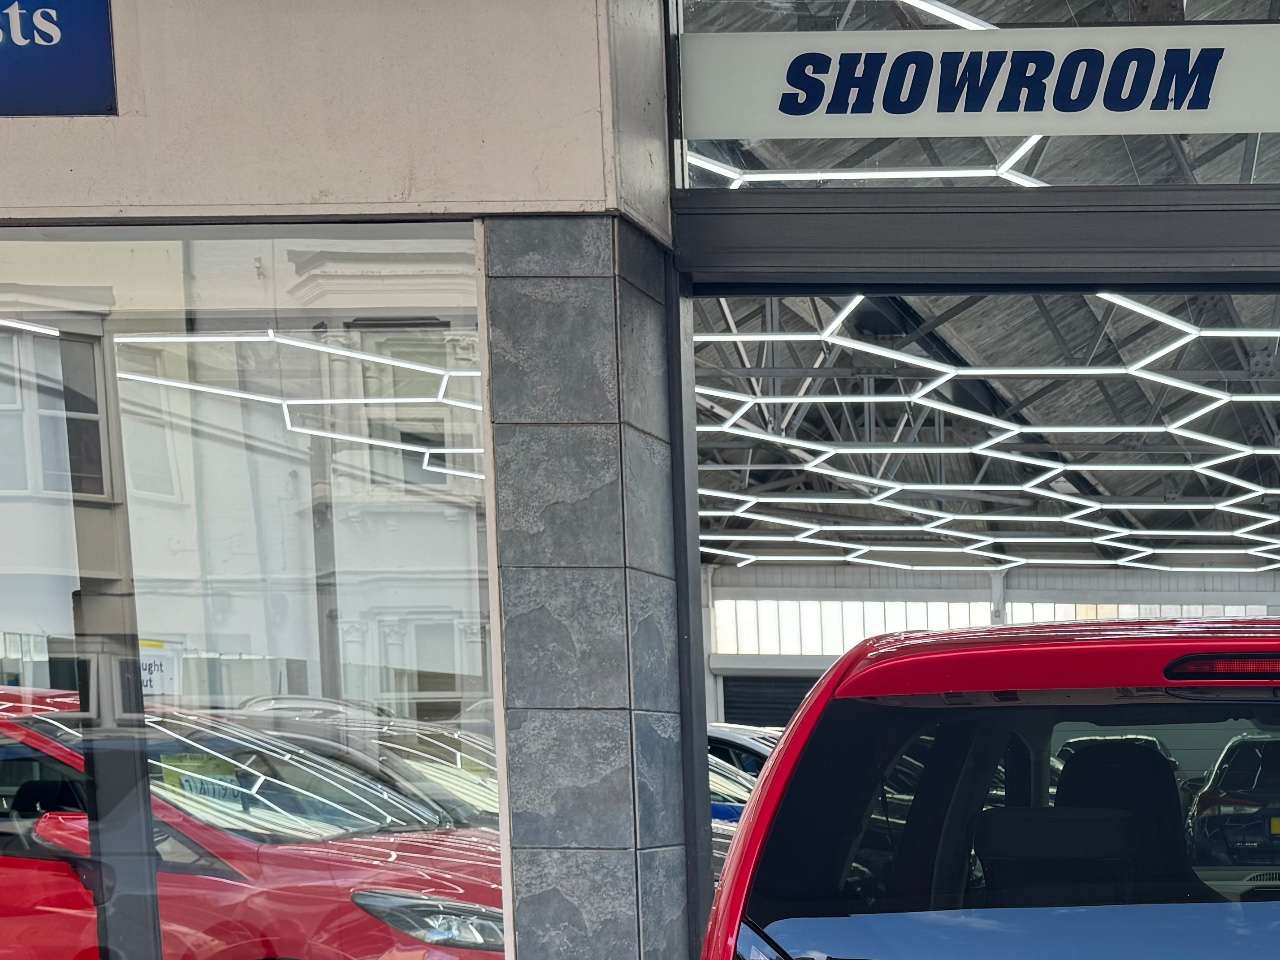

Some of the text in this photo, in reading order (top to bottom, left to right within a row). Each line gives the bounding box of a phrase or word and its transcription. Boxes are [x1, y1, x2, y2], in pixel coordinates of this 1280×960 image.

[0, 0, 61, 46] ts
[778, 47, 1225, 116] SHOWROOM
[141, 659, 164, 675] ught
[141, 677, 154, 689] ut
